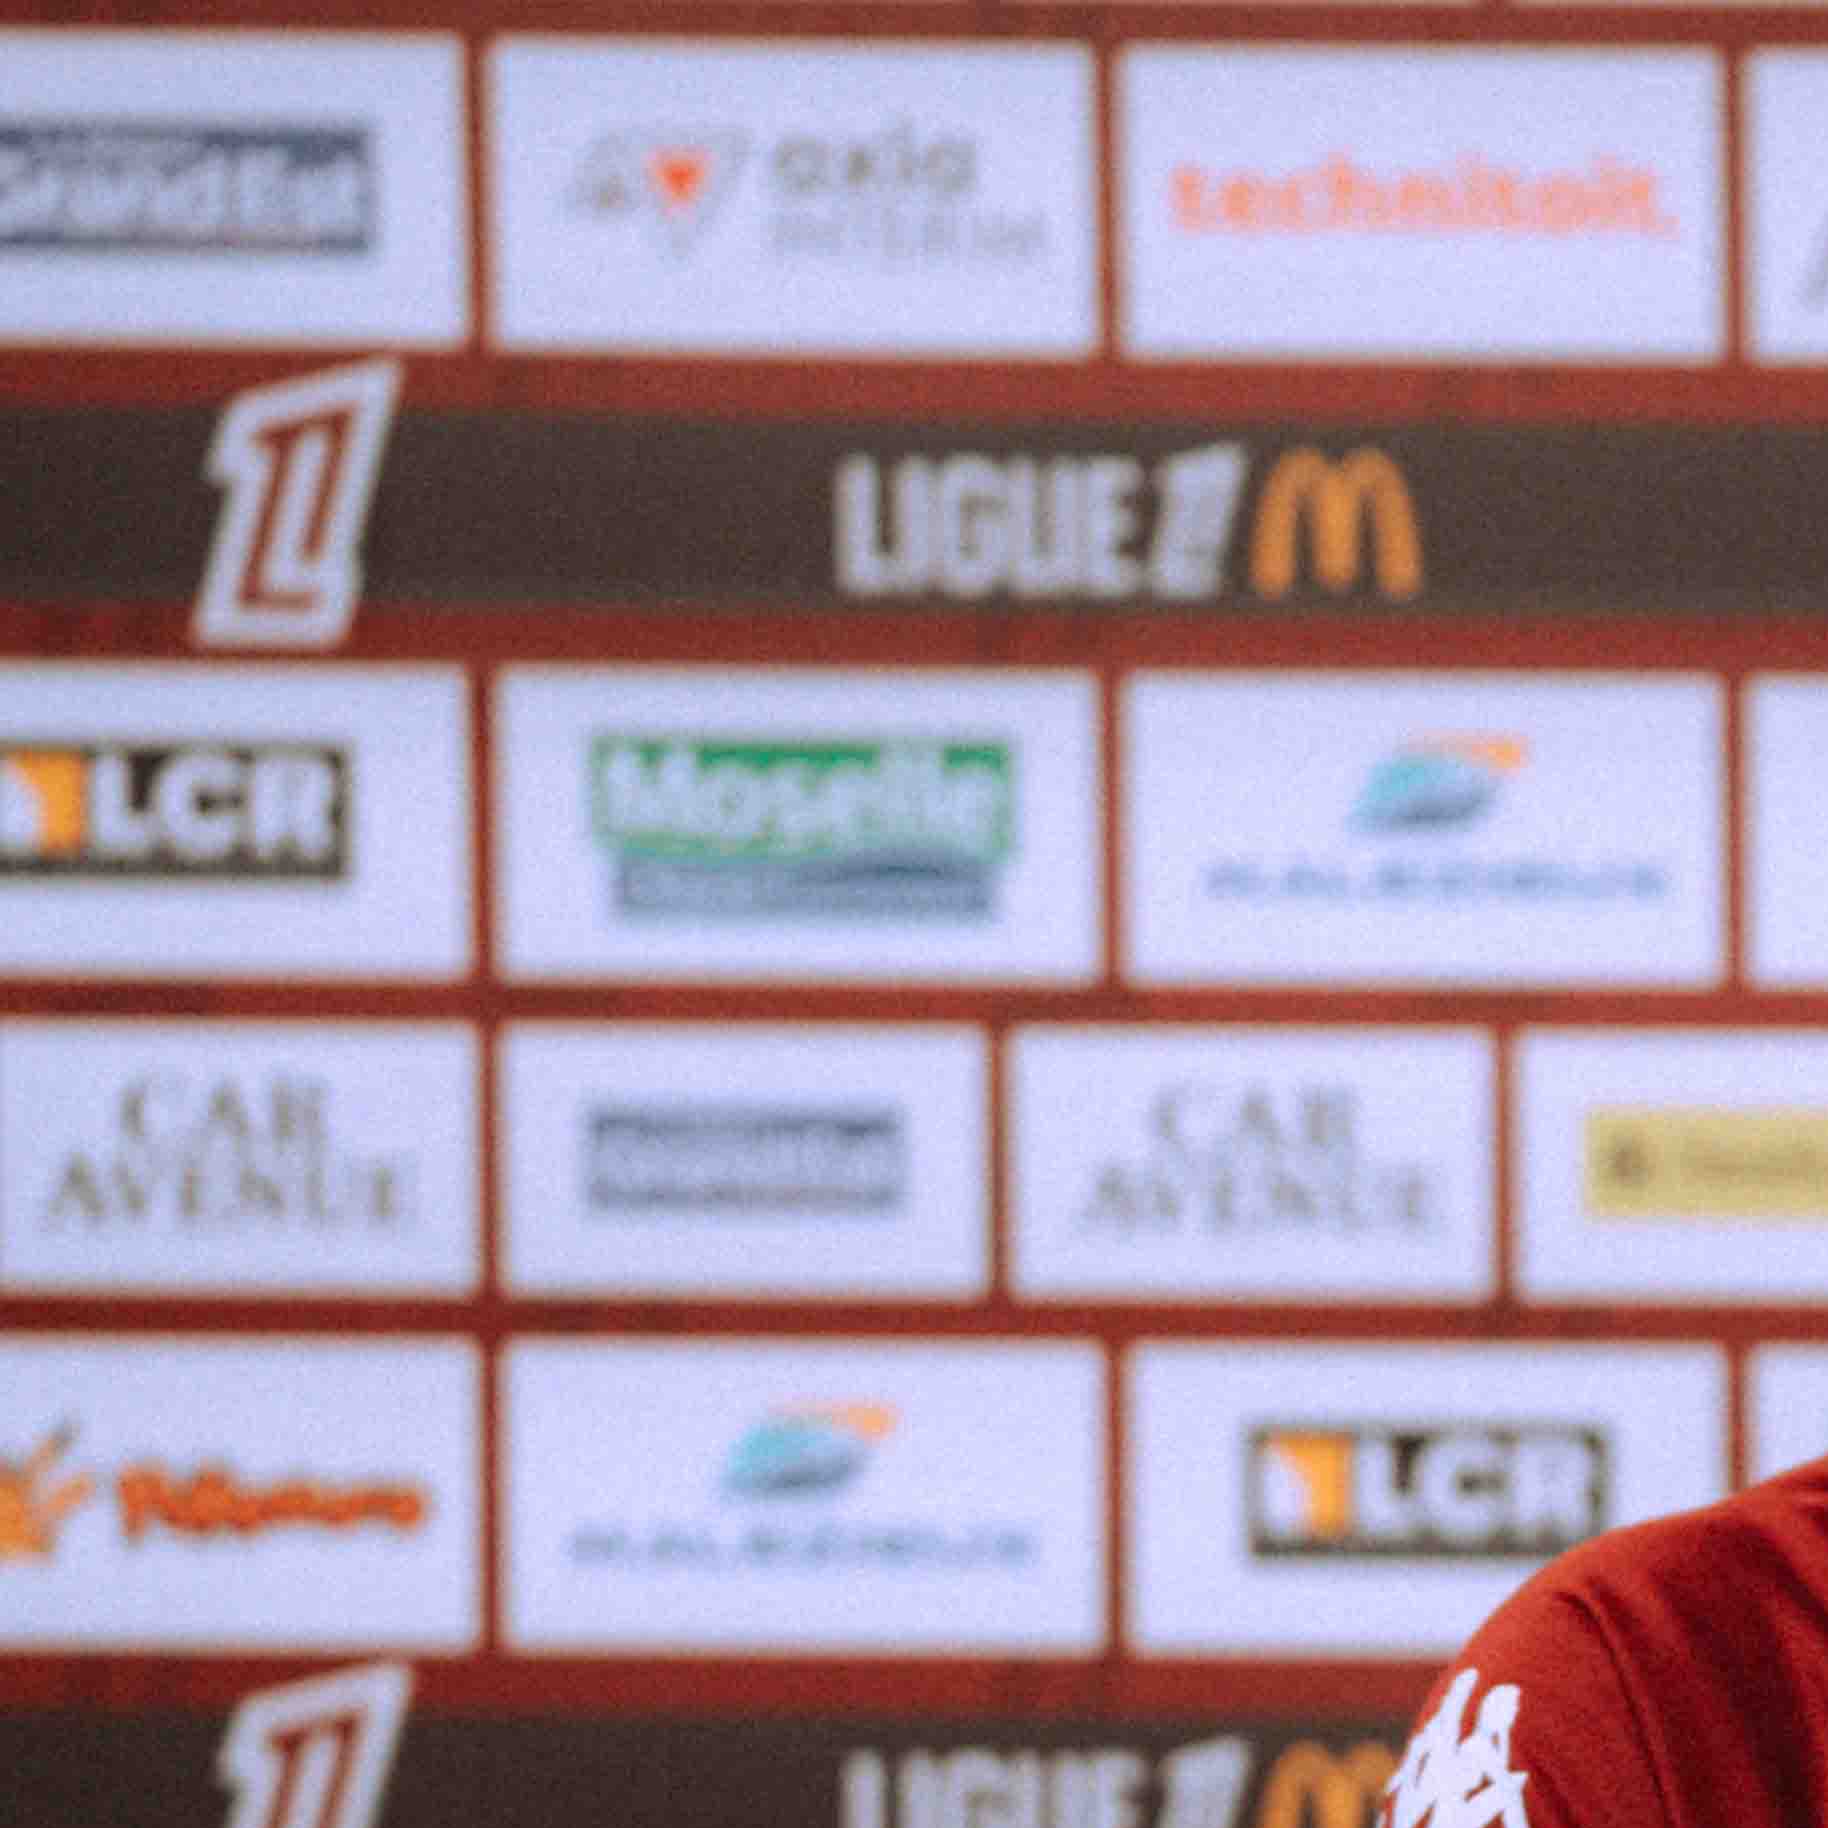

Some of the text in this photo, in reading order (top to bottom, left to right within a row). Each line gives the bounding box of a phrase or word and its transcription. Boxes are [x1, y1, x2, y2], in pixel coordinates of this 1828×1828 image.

[93, 750, 337, 860] LCR
[118, 1072, 328, 1147] CAR
[48, 1150, 417, 1230] AVENUE
[1354, 1434, 1597, 1534] LCR
